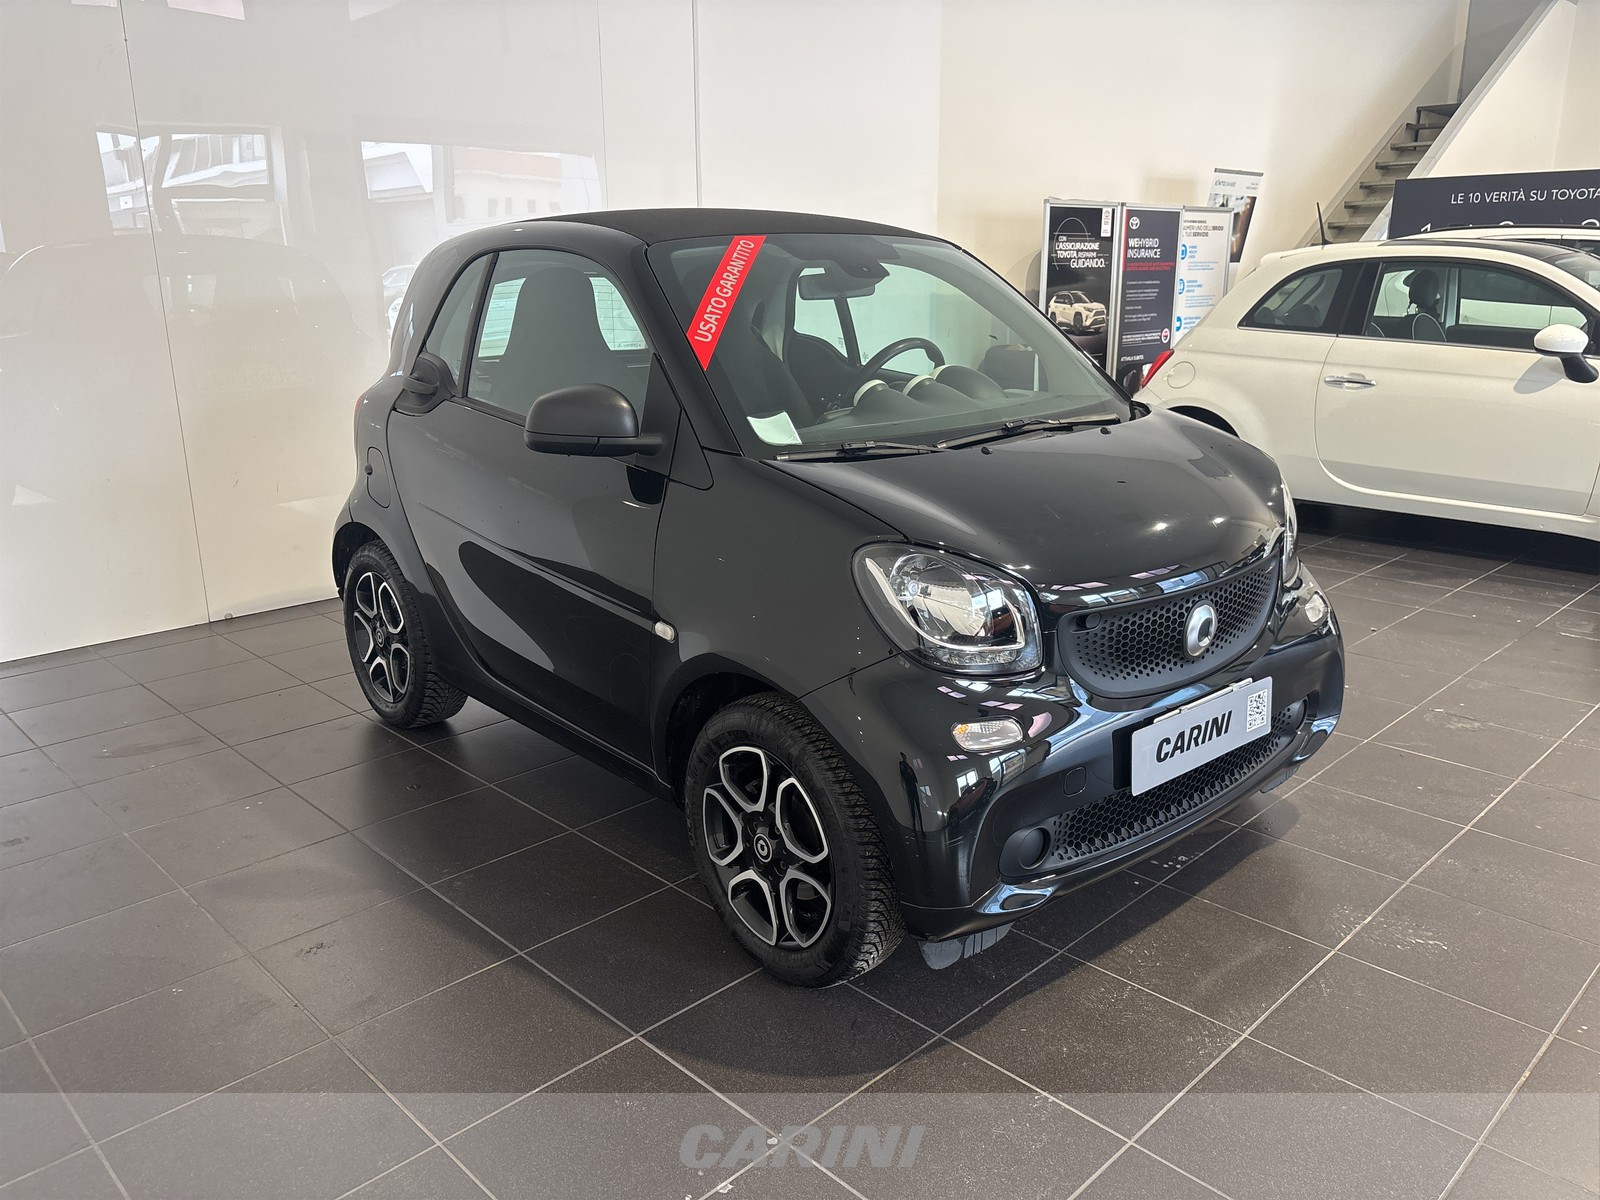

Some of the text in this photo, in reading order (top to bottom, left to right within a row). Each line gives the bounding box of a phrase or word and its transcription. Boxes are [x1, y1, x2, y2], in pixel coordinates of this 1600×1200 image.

[1451, 188, 1600, 204] LE 10 VERITÀ SU TOYOTA
[1055, 242, 1100, 250] L'ASSICURAZIONE
[1127, 249, 1161, 258] INSURANCE
[1070, 258, 1106, 268] GUIDANDO.
[694, 239, 755, 343] USATO GARANTITO
[1155, 710, 1233, 764] CARINI
